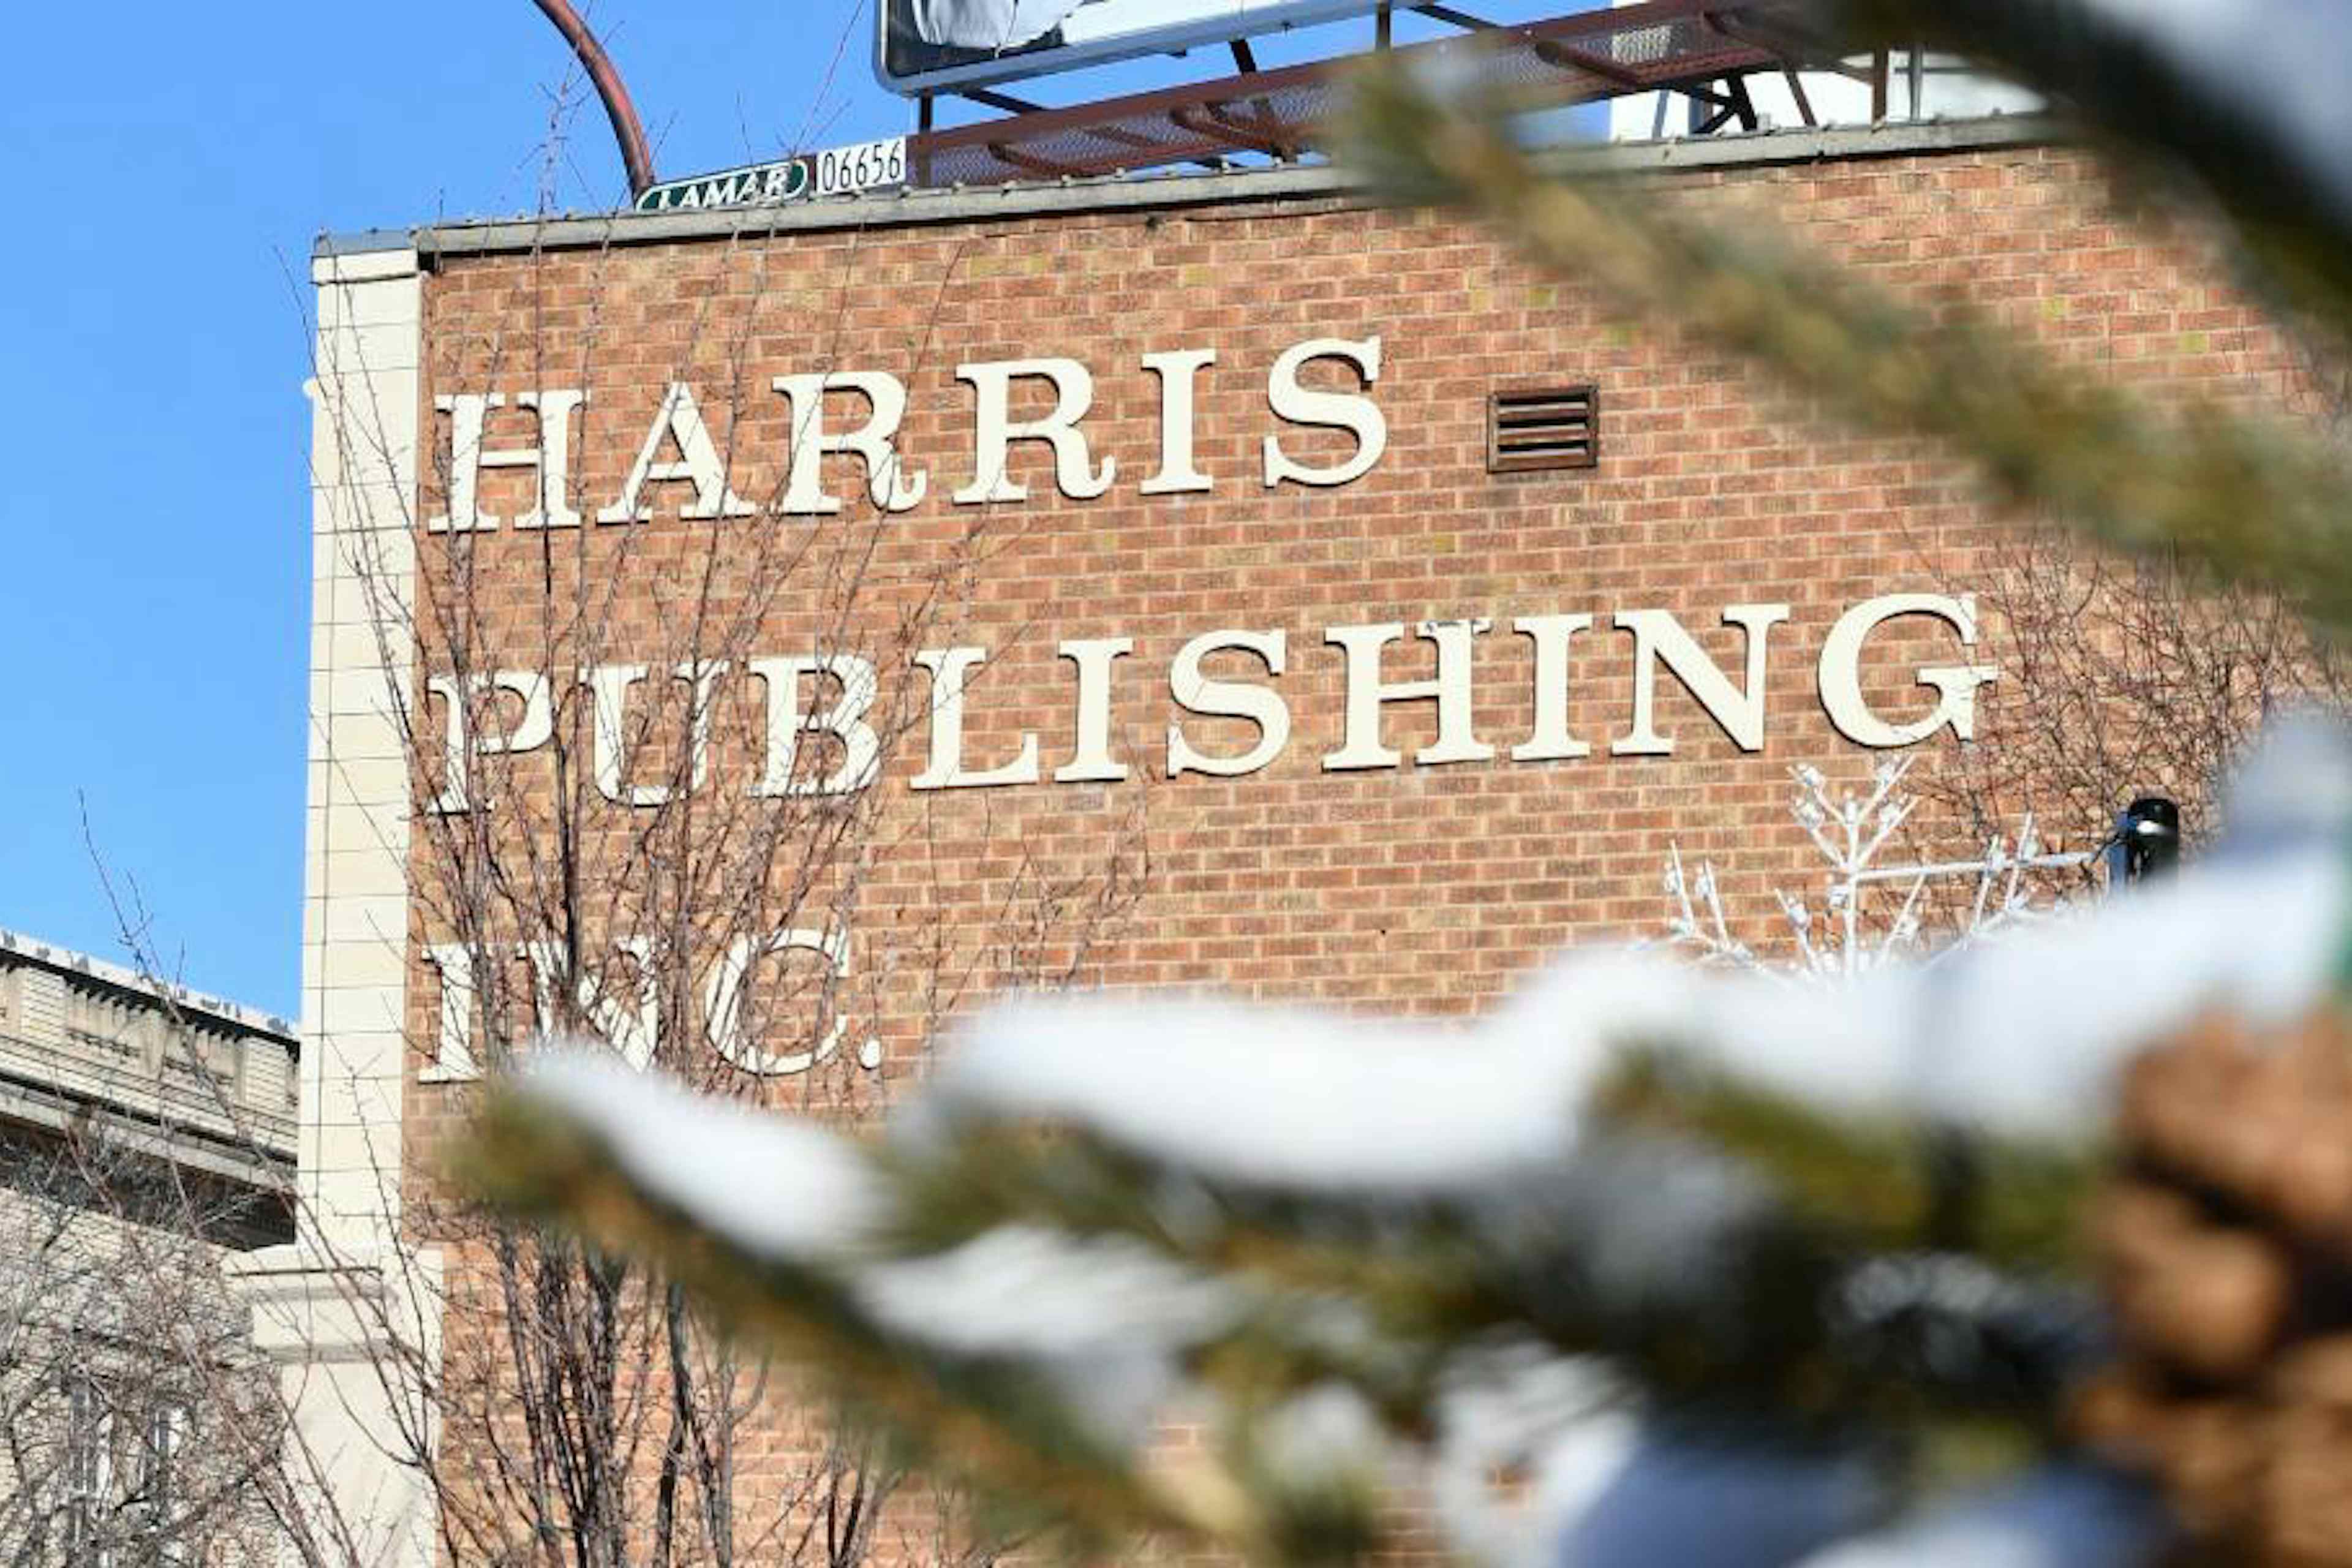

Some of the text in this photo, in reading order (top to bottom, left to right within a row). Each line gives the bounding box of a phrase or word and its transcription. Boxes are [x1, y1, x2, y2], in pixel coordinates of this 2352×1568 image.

[658, 167, 789, 211] LAMAR
[822, 141, 901, 190] 06656
[428, 336, 1387, 533] HARRIS
[428, 593, 1998, 815] PUBLISHING
